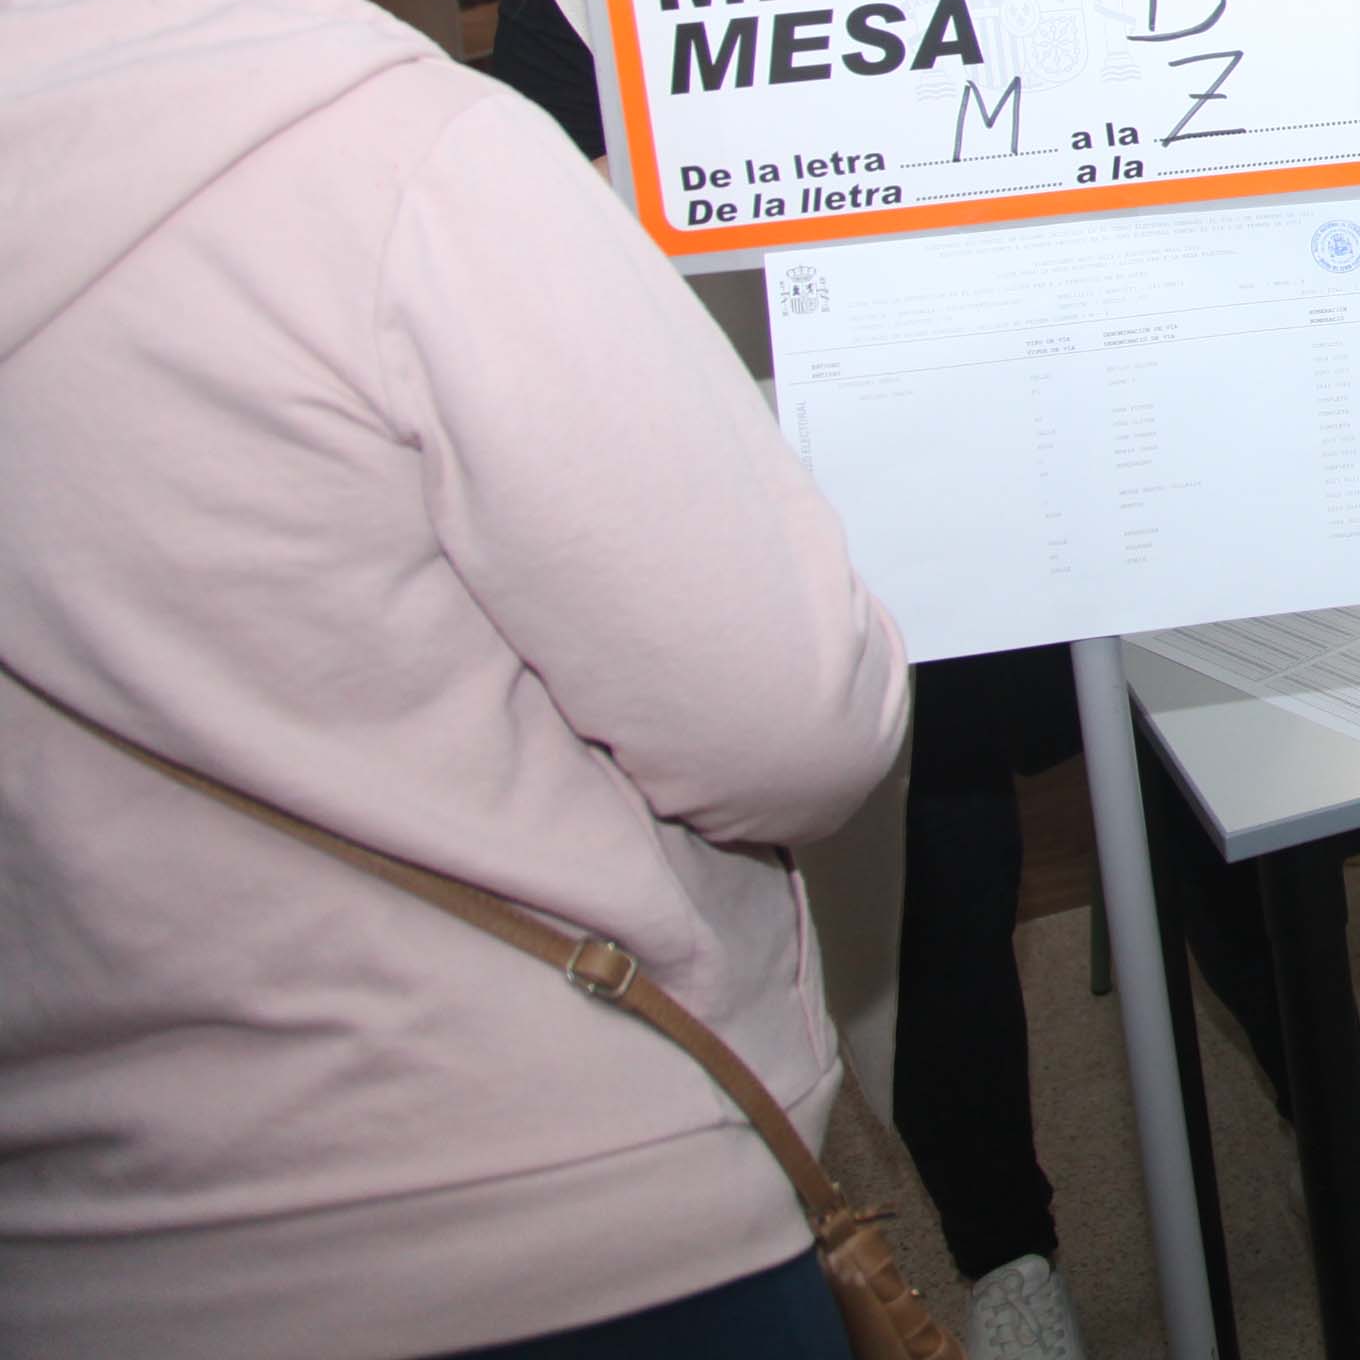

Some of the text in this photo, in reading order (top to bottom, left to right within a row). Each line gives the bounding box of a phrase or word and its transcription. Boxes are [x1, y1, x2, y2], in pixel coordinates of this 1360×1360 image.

[953, 75, 1022, 163] M
[1161, 50, 1247, 148] Z
[680, 120, 1141, 192] De la letra a la
[688, 154, 1145, 226] De la lletra a la
